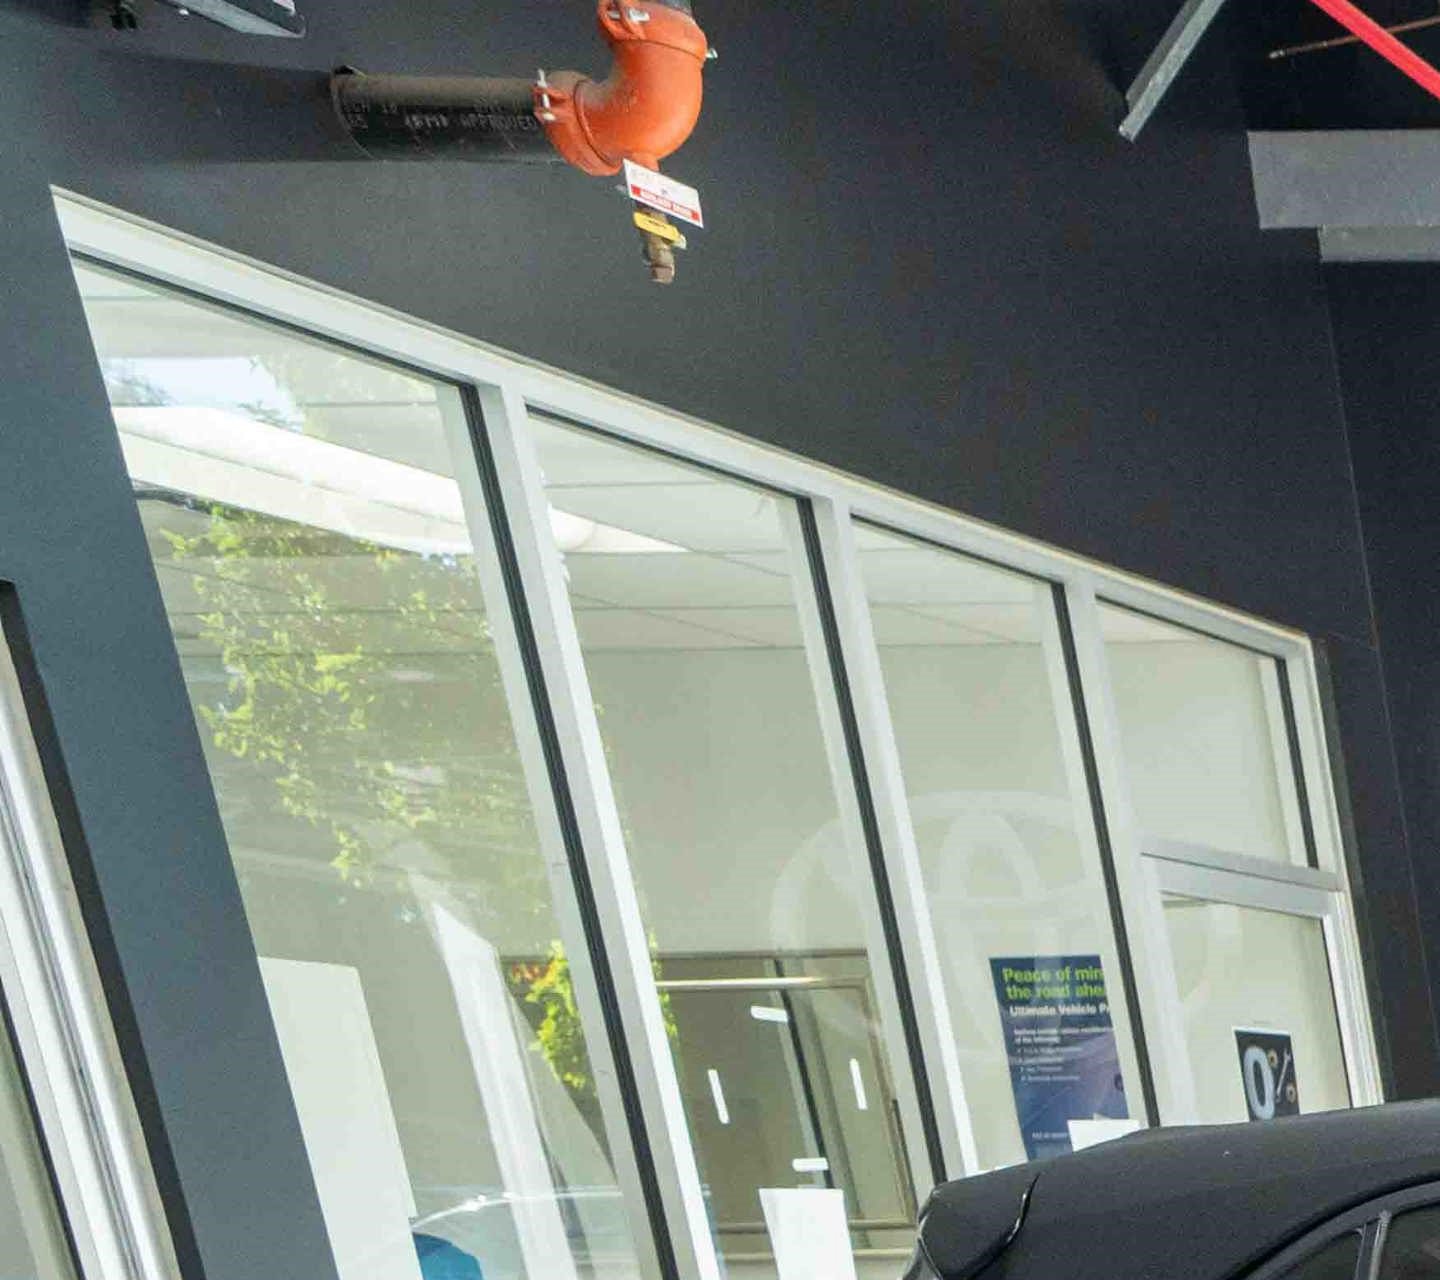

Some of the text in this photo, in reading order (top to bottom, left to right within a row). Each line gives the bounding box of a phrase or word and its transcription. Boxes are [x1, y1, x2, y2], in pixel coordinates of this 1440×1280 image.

[1002, 967, 1051, 983] Peace
[1056, 966, 1070, 983] of
[1006, 984, 1032, 999] the
[1035, 984, 1070, 999] road
